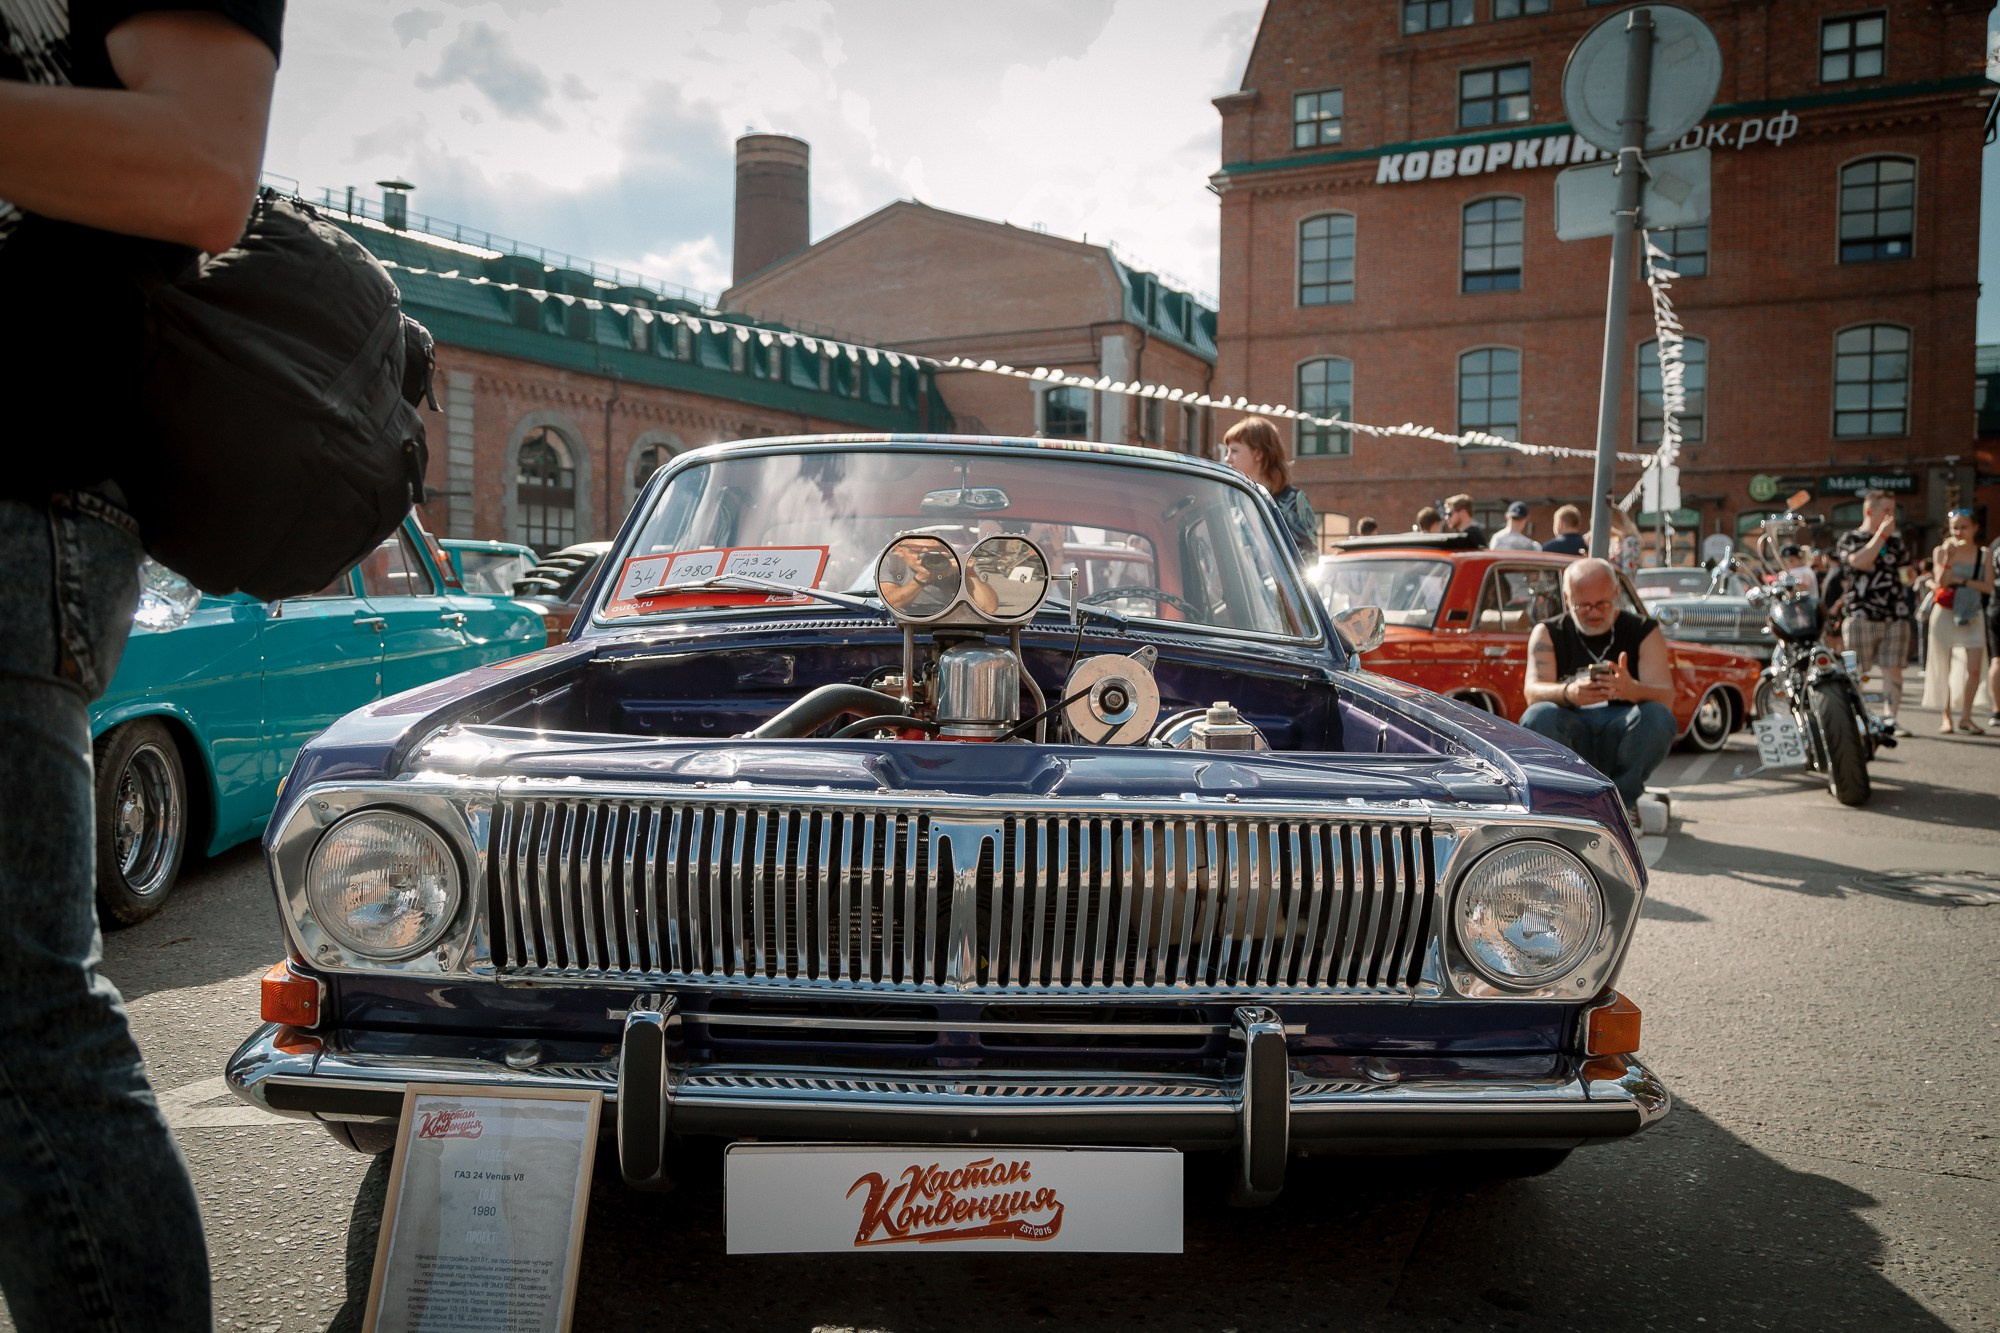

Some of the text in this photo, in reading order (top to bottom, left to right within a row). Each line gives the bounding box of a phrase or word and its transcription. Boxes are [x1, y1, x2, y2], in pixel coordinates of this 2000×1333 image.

[1827, 476, 1869, 491] Main
[731, 557, 782, 569] ГАЗ 24
[672, 564, 713, 579] 1980
[778, 568, 798, 580] V8
[630, 568, 657, 588] 34
[611, 600, 654, 612] auto.ru
[436, 1109, 476, 1121] Кастом
[419, 1112, 482, 1139] Конвенция
[454, 1170, 525, 1181] ГАЗ 24 Venus V8
[899, 1157, 1031, 1206] Кастом
[472, 1205, 497, 1217] 1980
[845, 1172, 1064, 1246] Конвенция
[1020, 1224, 1053, 1236] EST. 2015
